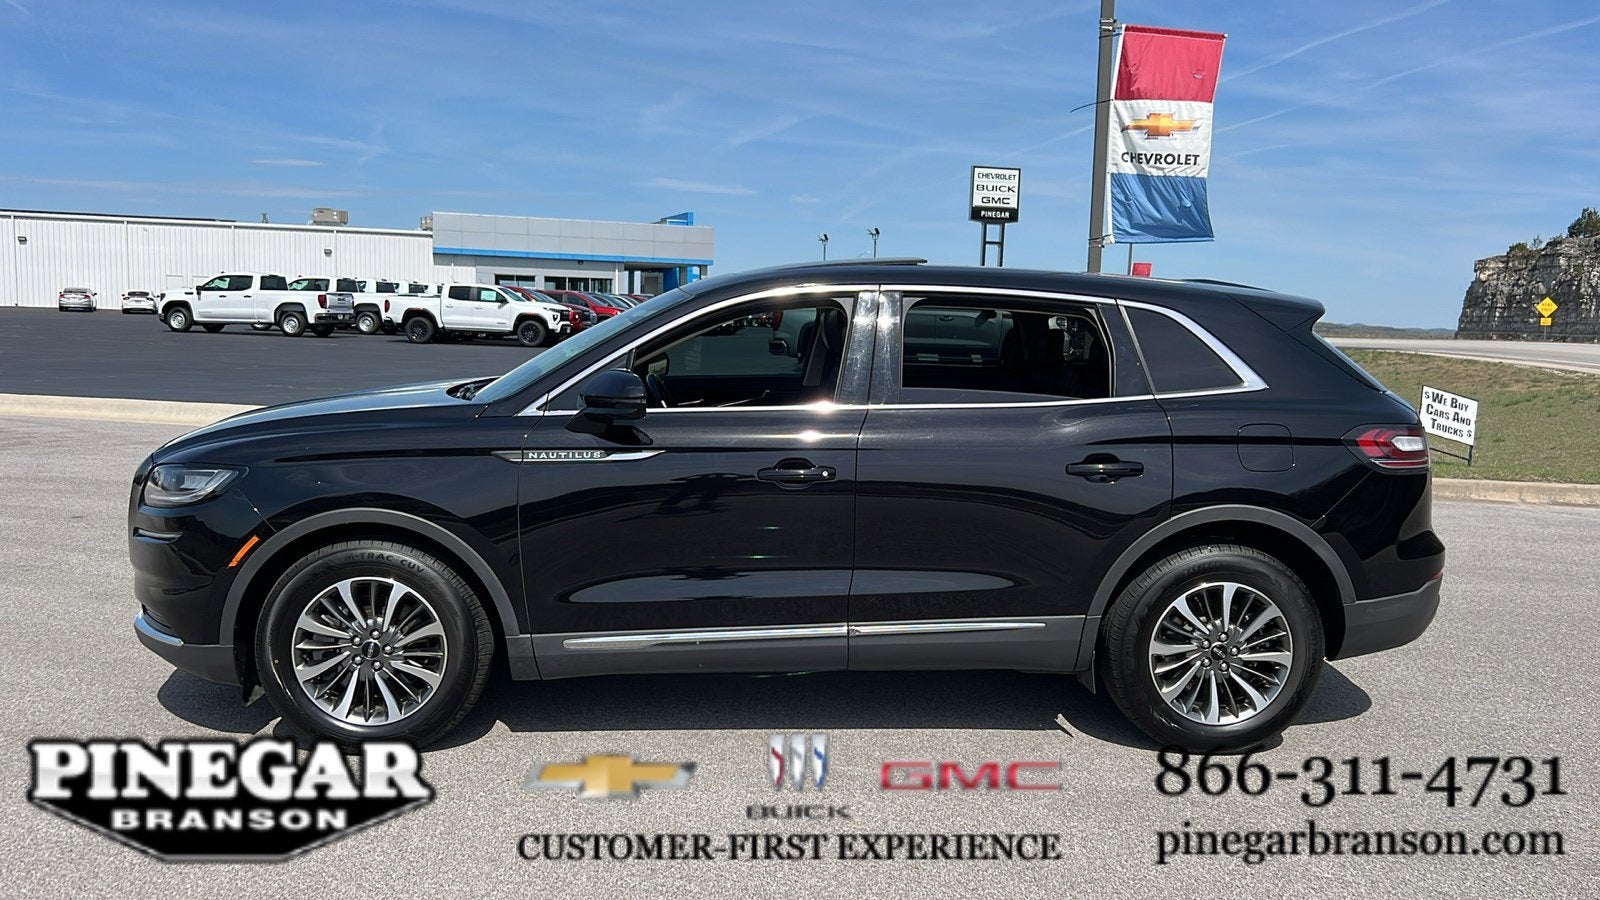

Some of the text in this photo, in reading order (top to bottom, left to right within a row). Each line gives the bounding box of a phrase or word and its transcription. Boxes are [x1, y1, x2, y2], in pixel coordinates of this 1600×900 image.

[1121, 151, 1200, 166] CHEVROLET
[977, 172, 1016, 181] CHEVROLET
[976, 184, 1016, 193] BUICK
[981, 196, 1011, 205] GMC
[980, 210, 1010, 219] PINEGAR
[528, 451, 602, 459] NAUTILUS
